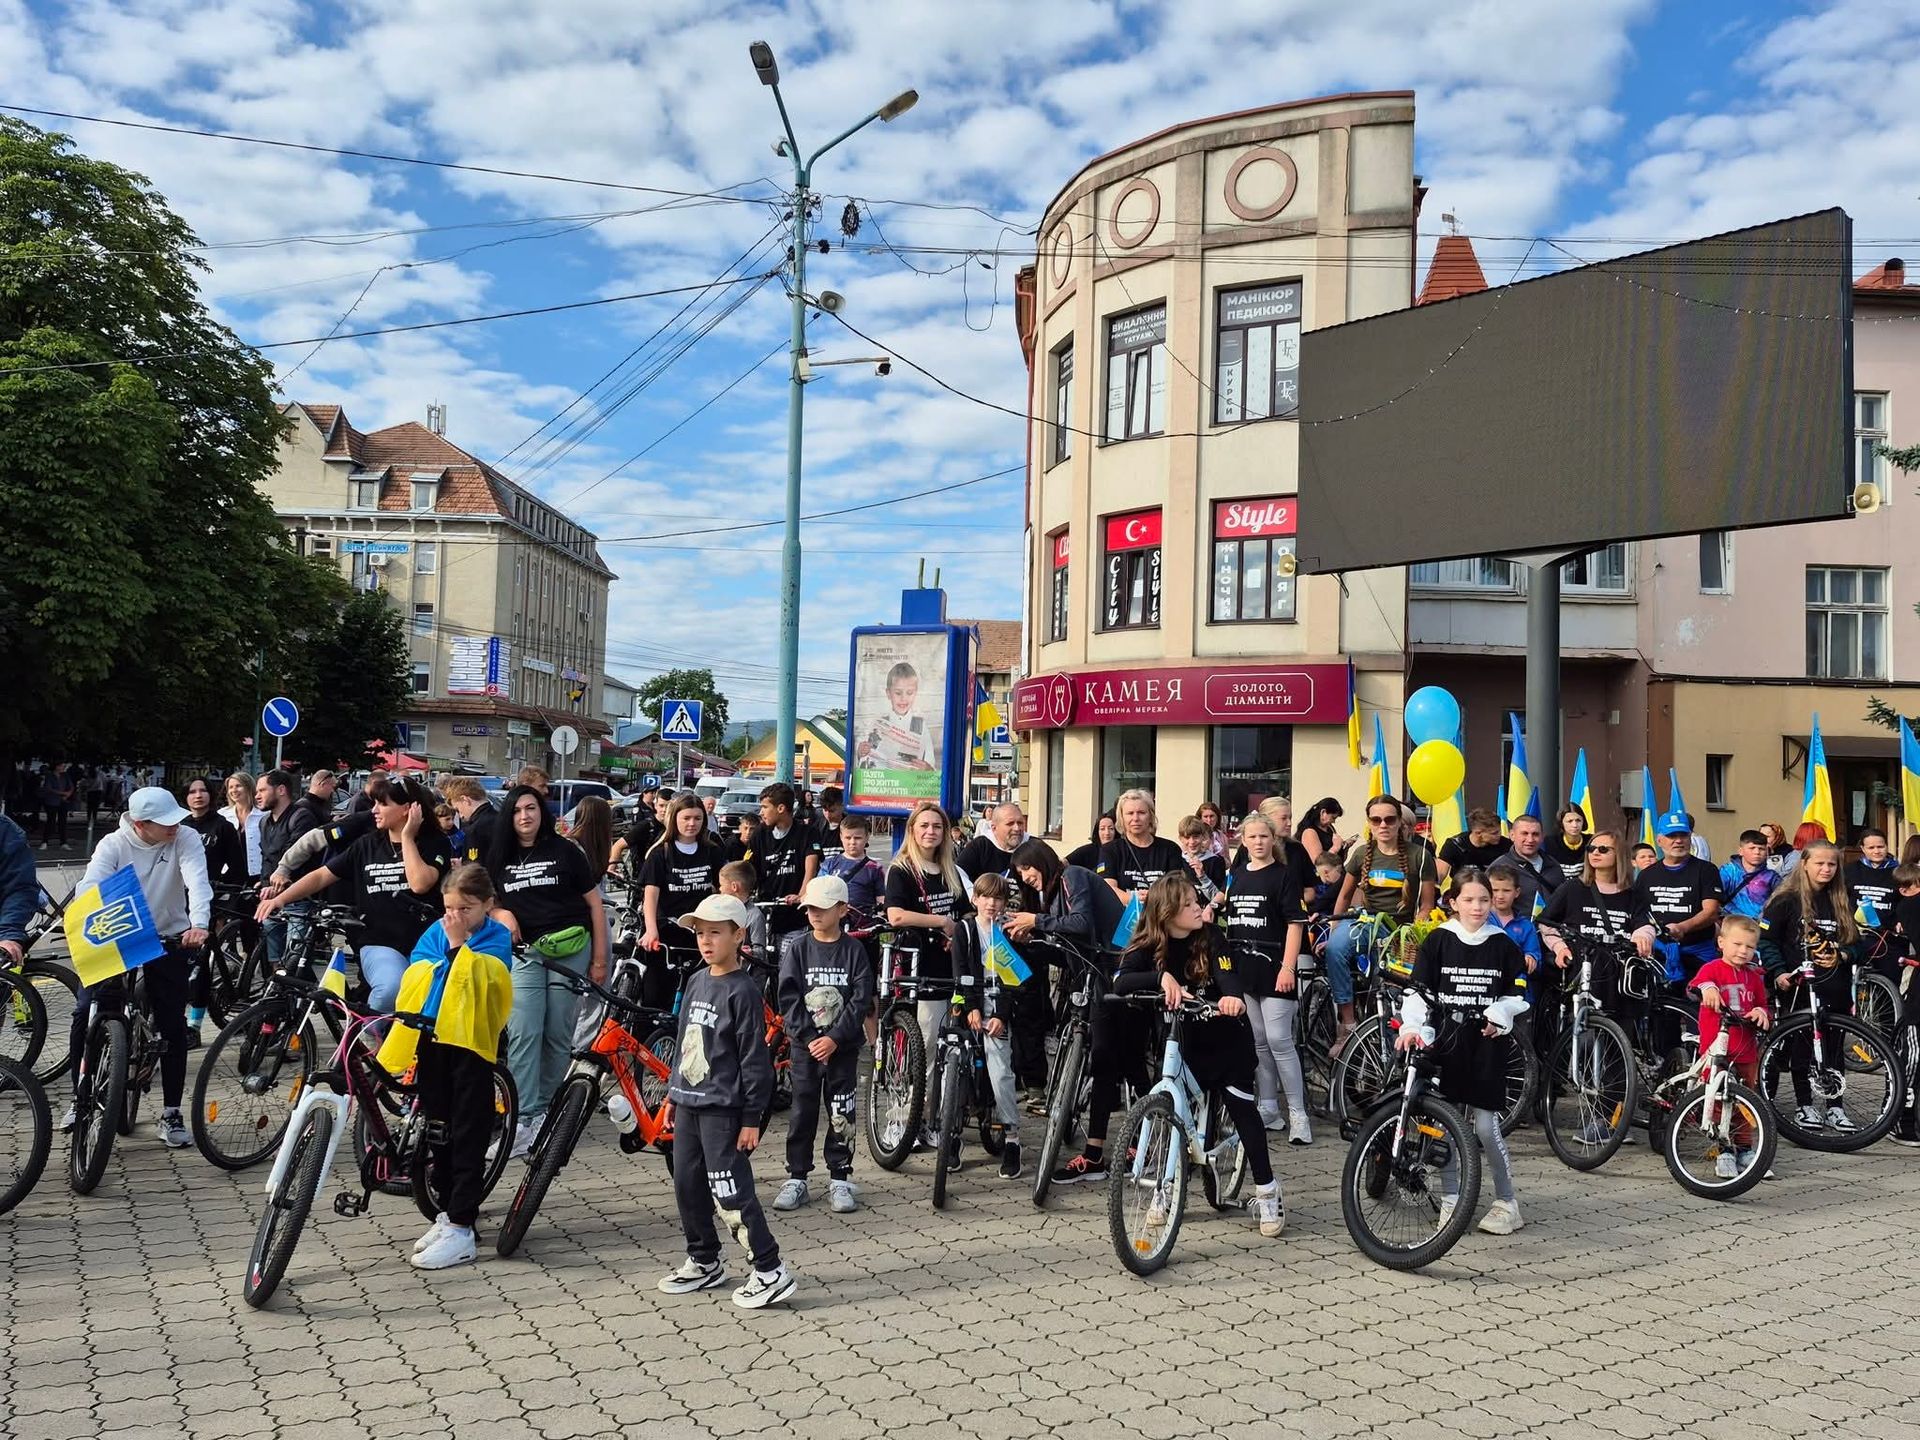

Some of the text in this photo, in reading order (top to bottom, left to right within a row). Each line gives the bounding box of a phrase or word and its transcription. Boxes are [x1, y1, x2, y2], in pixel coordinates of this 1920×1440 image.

[1227, 288, 1294, 306] МАНІКЮР
[1112, 310, 1165, 333] ВИДАЛЕННЯ
[1227, 303, 1293, 320] ПЕДИКЮР
[1224, 503, 1288, 533] Style
[1108, 555, 1121, 626] City
[1150, 550, 1161, 622] Style
[1084, 678, 1183, 705] КАМЕЯ
[1224, 695, 1293, 706] ДІАМАНТИ
[1094, 706, 1168, 715] ЮВЕЛІРНА МЕРЕЖА
[805, 973, 849, 986] T-REX
